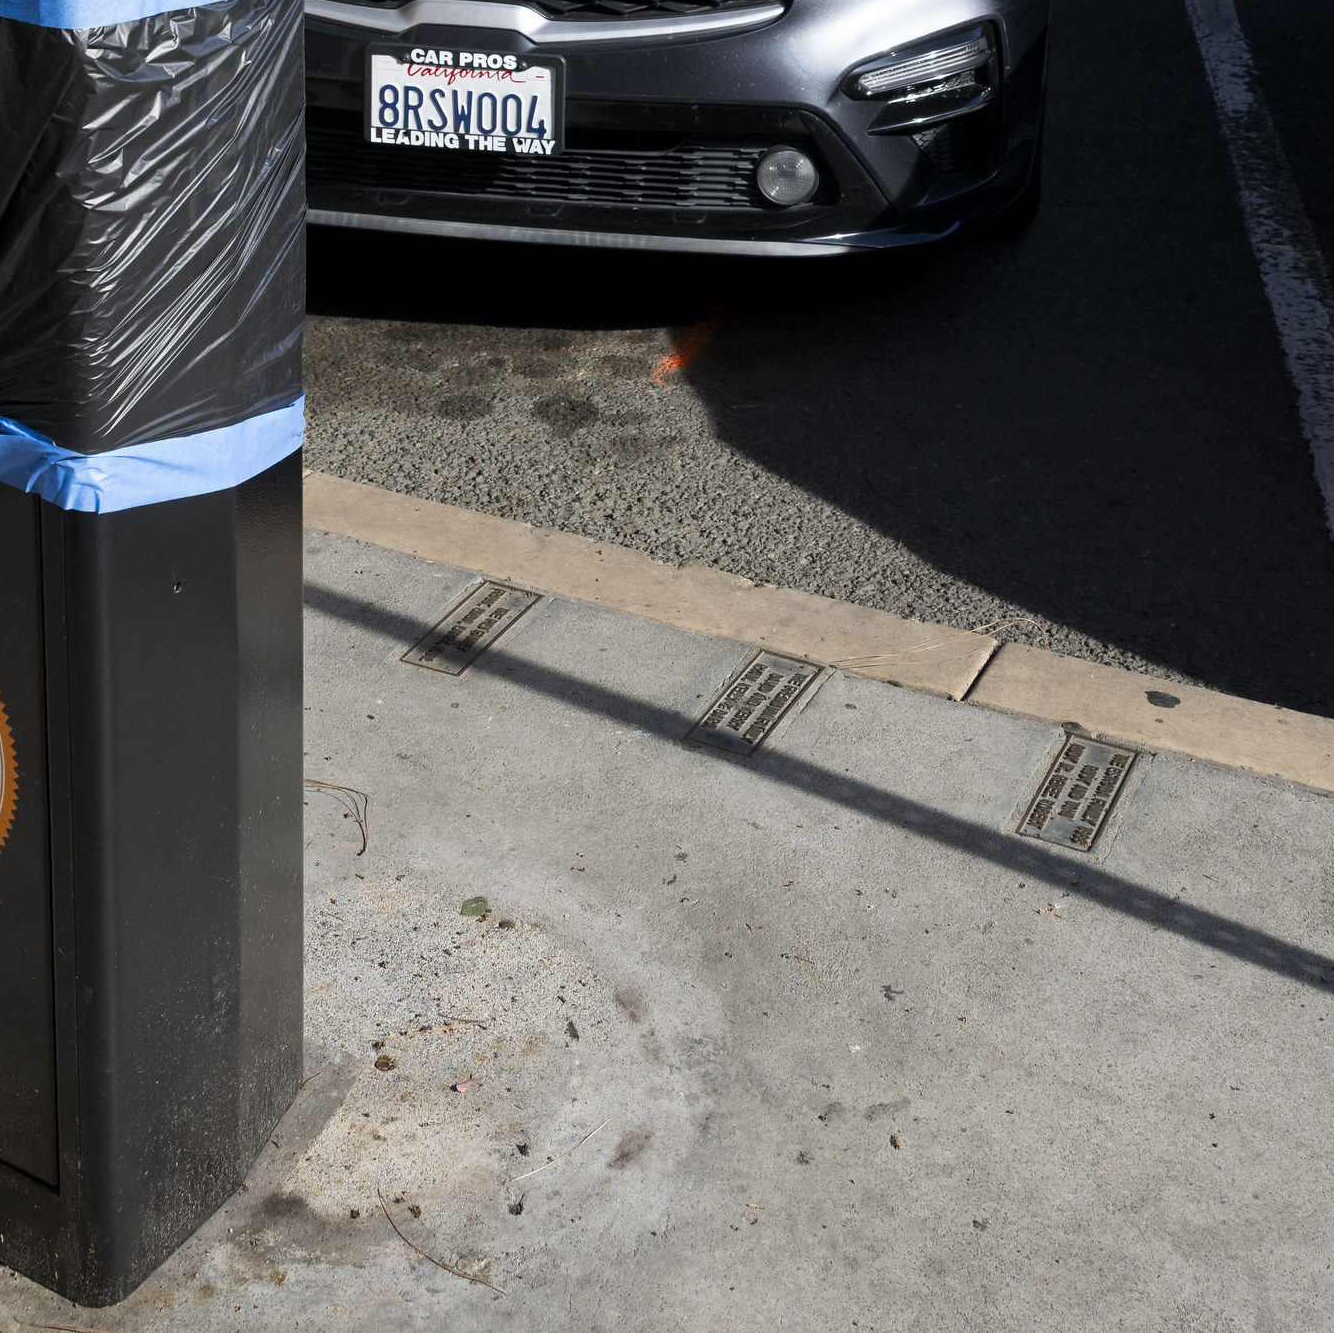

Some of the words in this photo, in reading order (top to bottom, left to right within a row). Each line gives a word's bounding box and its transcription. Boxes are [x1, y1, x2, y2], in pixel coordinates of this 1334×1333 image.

[410, 48, 454, 66] CAR
[459, 51, 518, 70] PROS
[407, 63, 527, 85] California
[378, 84, 547, 137] 8RSW004
[370, 127, 460, 149] LEADING
[465, 135, 507, 152] THE
[513, 137, 556, 155] WAY
